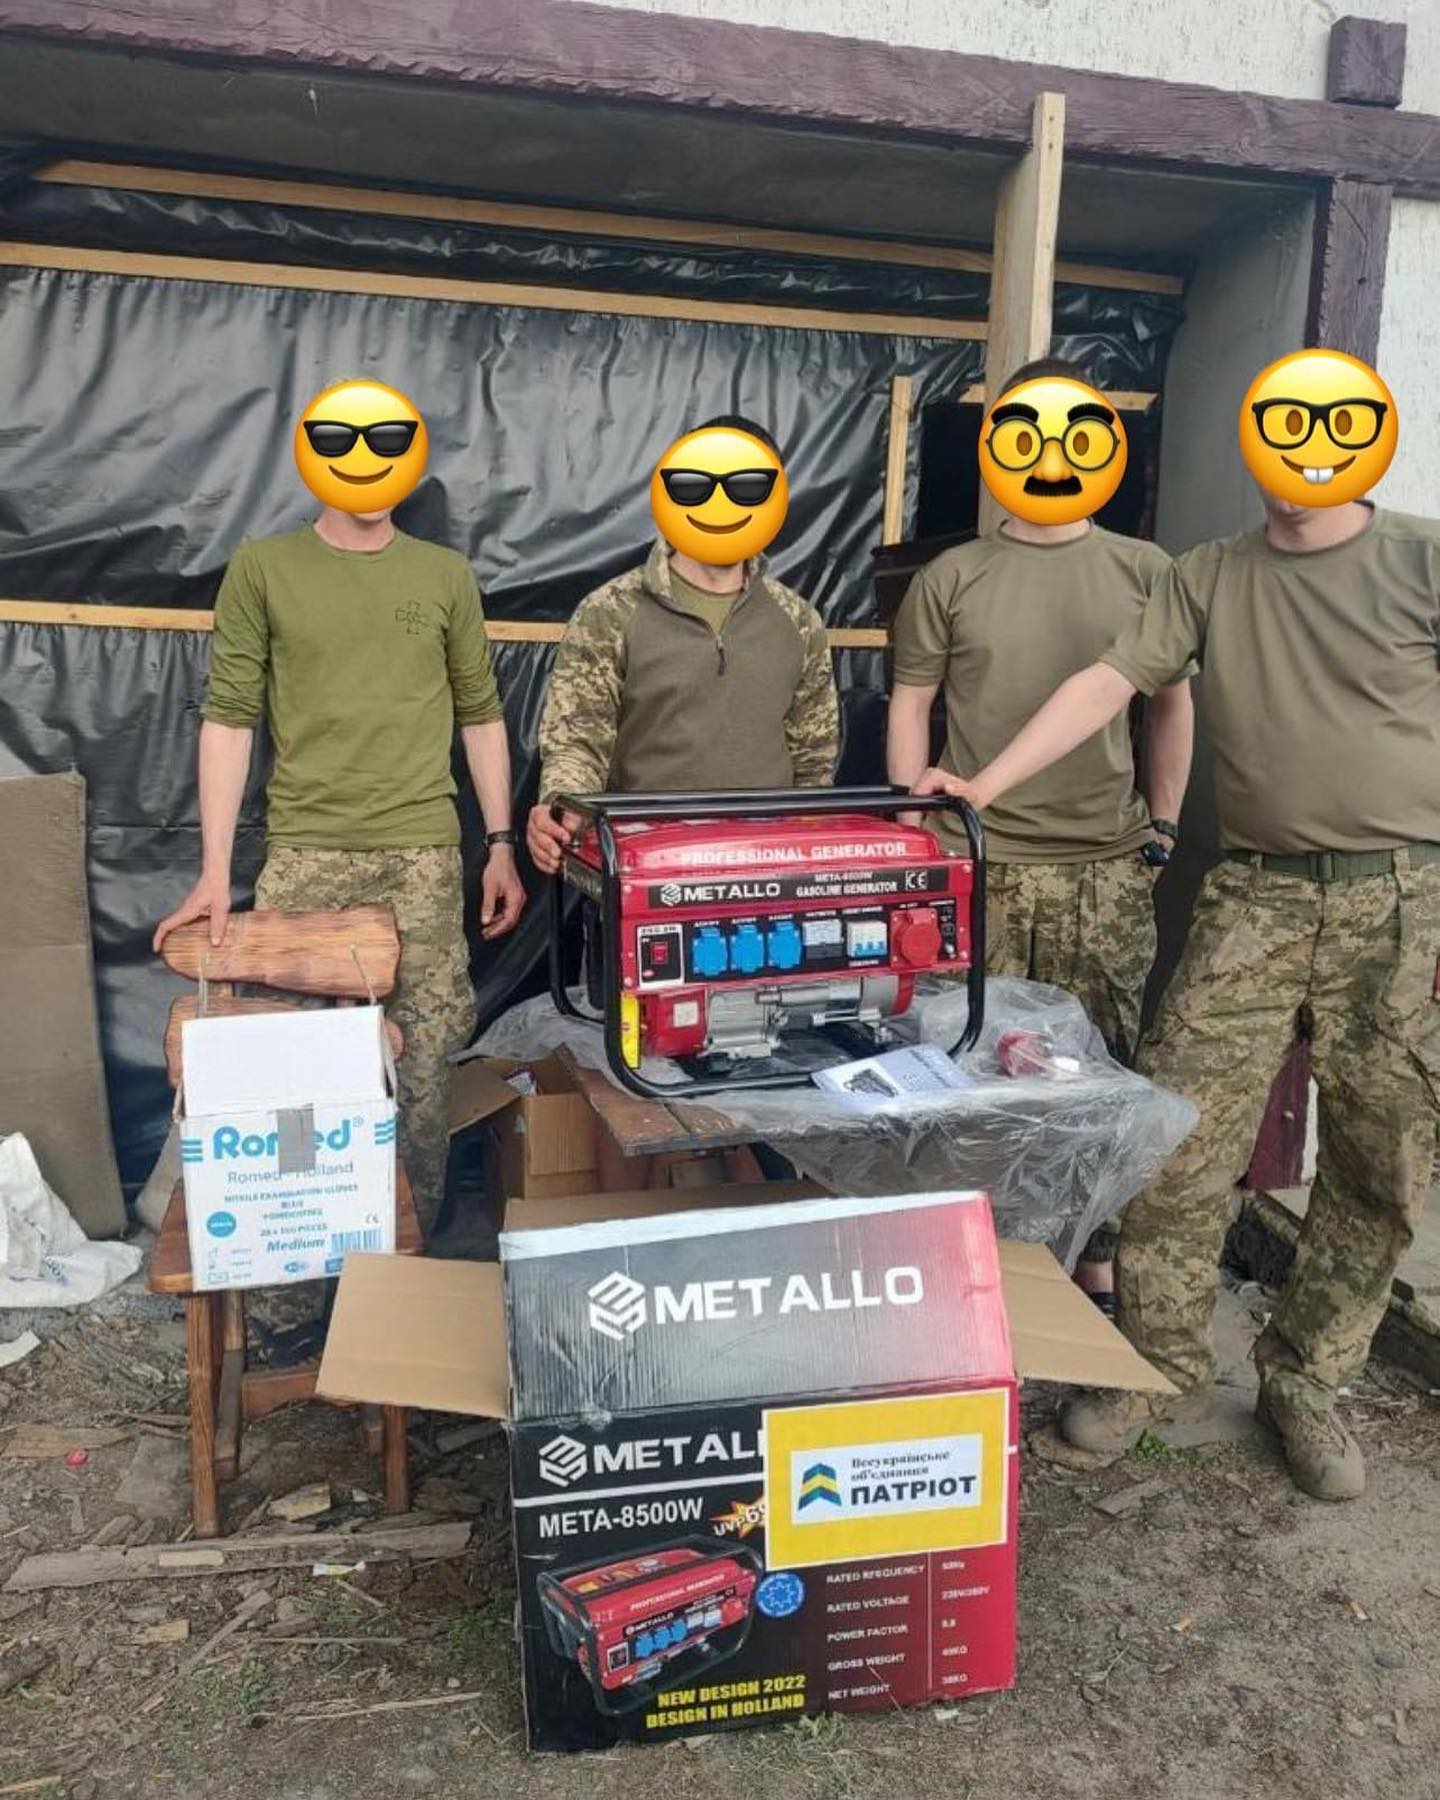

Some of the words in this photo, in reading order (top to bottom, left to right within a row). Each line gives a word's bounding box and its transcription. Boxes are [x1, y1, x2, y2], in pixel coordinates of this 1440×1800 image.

[681, 849, 804, 865] PROFESSIONAL
[811, 842, 906, 858] GENERATOR
[684, 883, 781, 901] METALLO
[843, 881, 898, 895] GENERATOR
[213, 1119, 351, 1160] Roed
[267, 1238, 326, 1252] Medium
[654, 1266, 924, 1325] METALLO
[852, 1450, 951, 1469] Всеукраїнське
[851, 1475, 977, 1506] ПАТРІОТ
[539, 1497, 704, 1538] META-8500W
[827, 1571, 861, 1584] RATED
[827, 1601, 861, 1613] RATED
[863, 1595, 910, 1608] VOLTAGE
[827, 1630, 865, 1643] POWER
[867, 1624, 909, 1637] FACTOR
[827, 1658, 864, 1671] GROSS
[866, 1653, 905, 1666] WEIGHT
[658, 1689, 696, 1708] NEW
[699, 1680, 759, 1700] DESIGN
[763, 1675, 807, 1692] 2022
[828, 1689, 848, 1700] NET
[850, 1684, 890, 1697] WEIGHT
[646, 1707, 707, 1728] DESIGN
[710, 1704, 729, 1719] IN
[732, 1693, 805, 1716] HOLLAND
